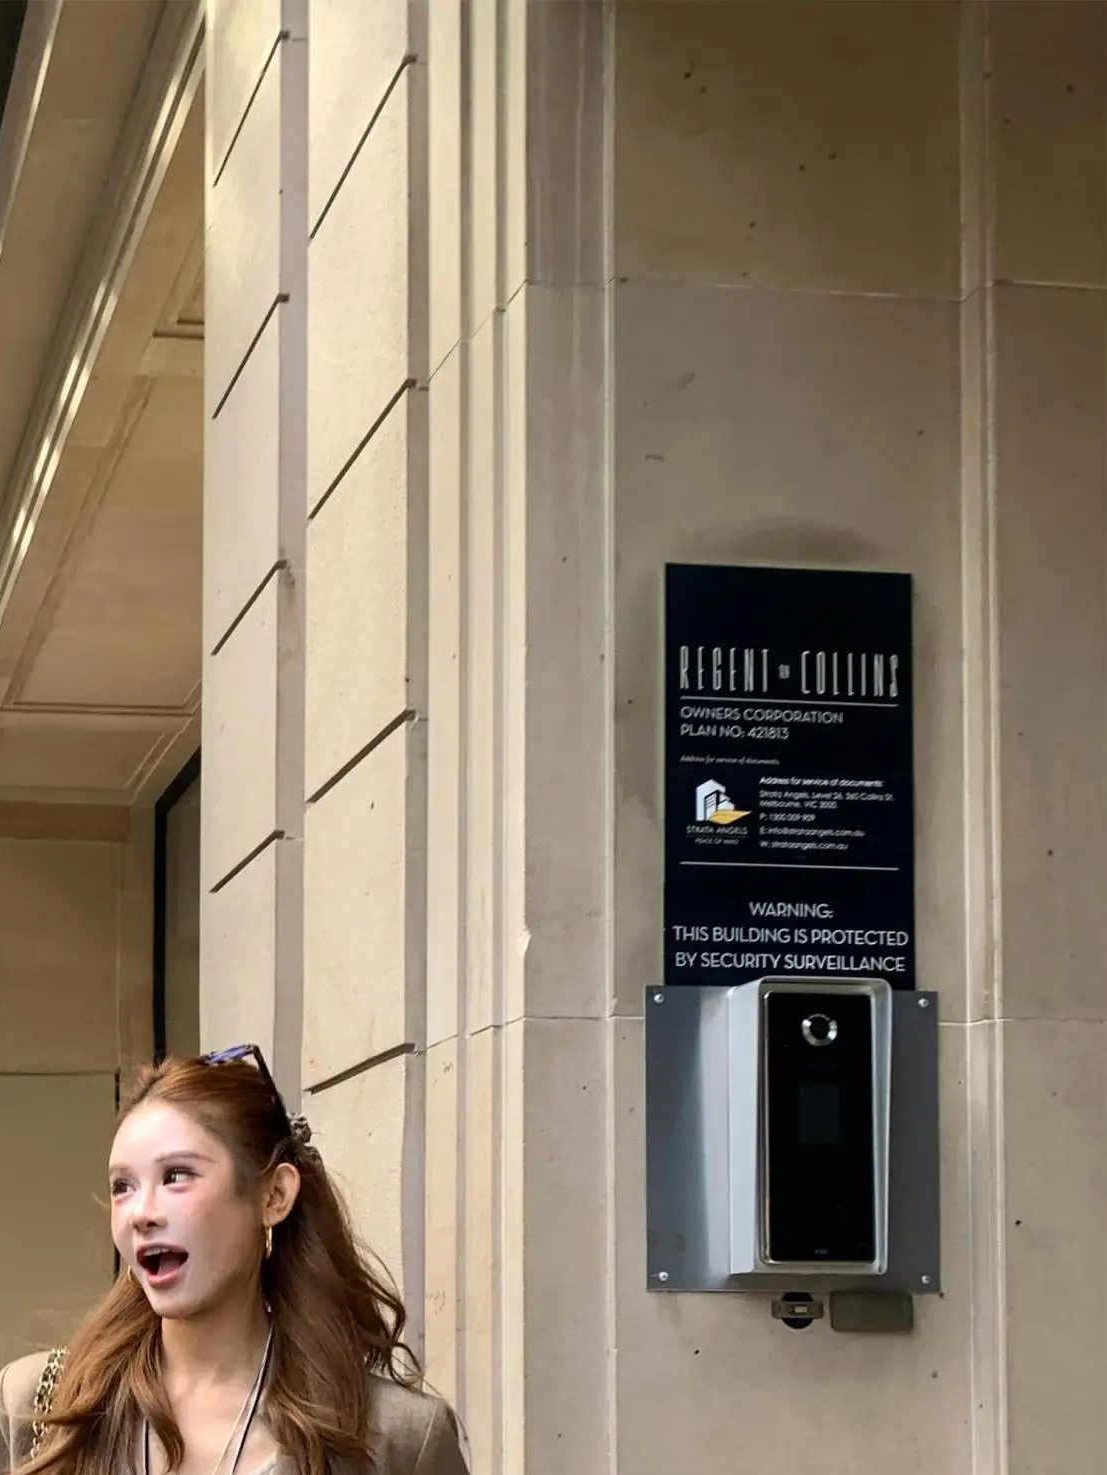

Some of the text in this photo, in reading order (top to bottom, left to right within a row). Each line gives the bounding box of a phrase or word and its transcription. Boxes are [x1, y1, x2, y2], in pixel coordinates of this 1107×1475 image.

[679, 645, 769, 693] REGENT
[801, 650, 898, 698] COLLINS
[680, 705, 844, 724] OWNERS CORPORATION
[680, 723, 717, 737] PLAN
[747, 726, 789, 740] 421813
[749, 901, 834, 919] WARNING:
[672, 925, 909, 947] THIS BUILDING IS PROTECTED
[675, 951, 906, 972] BY SECURITY SURVEILLANCE
